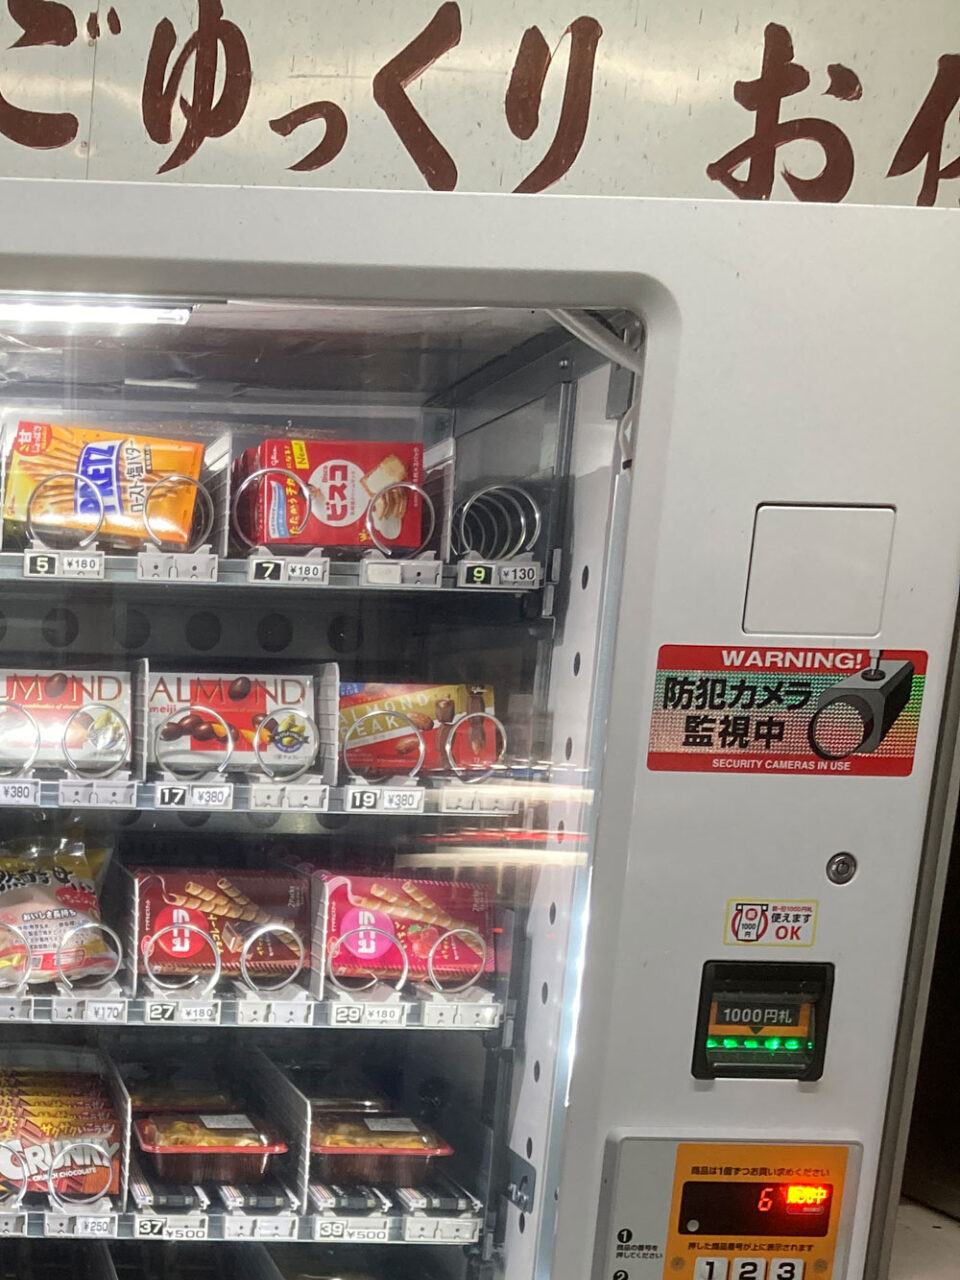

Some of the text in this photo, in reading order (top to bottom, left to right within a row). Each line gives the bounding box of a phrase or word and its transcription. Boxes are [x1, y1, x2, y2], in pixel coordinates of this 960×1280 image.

[18, 430, 32, 444] 甘
[78, 445, 116, 514] PRETZ
[327, 464, 348, 521] ビスコ
[36, 558, 95, 571] 5 ¥180
[262, 563, 319, 577] 7 ¥180
[473, 567, 535, 581] 9 ¥130
[722, 650, 862, 669] WARNING!
[663, 676, 813, 710] 防犯カメラ
[149, 705, 177, 713] meiji
[683, 715, 785, 749] 監視中
[712, 759, 850, 771] SECURITY CAMERAS IN USE
[4, 787, 30, 798] ¥380
[162, 789, 224, 802] 17 ¥380
[354, 793, 414, 806] 19 ¥380
[771, 913, 812, 923] 使えます
[172, 909, 190, 952] ピコラ
[208, 914, 224, 953] チョコレート
[358, 911, 376, 953] ピコラ
[775, 926, 803, 940] OK
[94, 1007, 119, 1018] ¥170
[151, 1006, 174, 1018] 27
[337, 1008, 395, 1021] 29 ¥180
[723, 1008, 792, 1023] 1000円札
[59, 1167, 97, 1178] CHOCOLATE
[758, 1188, 773, 1212] 6
[84, 1221, 108, 1232] ¥250
[140, 1220, 205, 1238] 37 ¥500
[321, 1223, 386, 1239] 39 ¥500
[705, 1261, 796, 1280] 1 2 3
